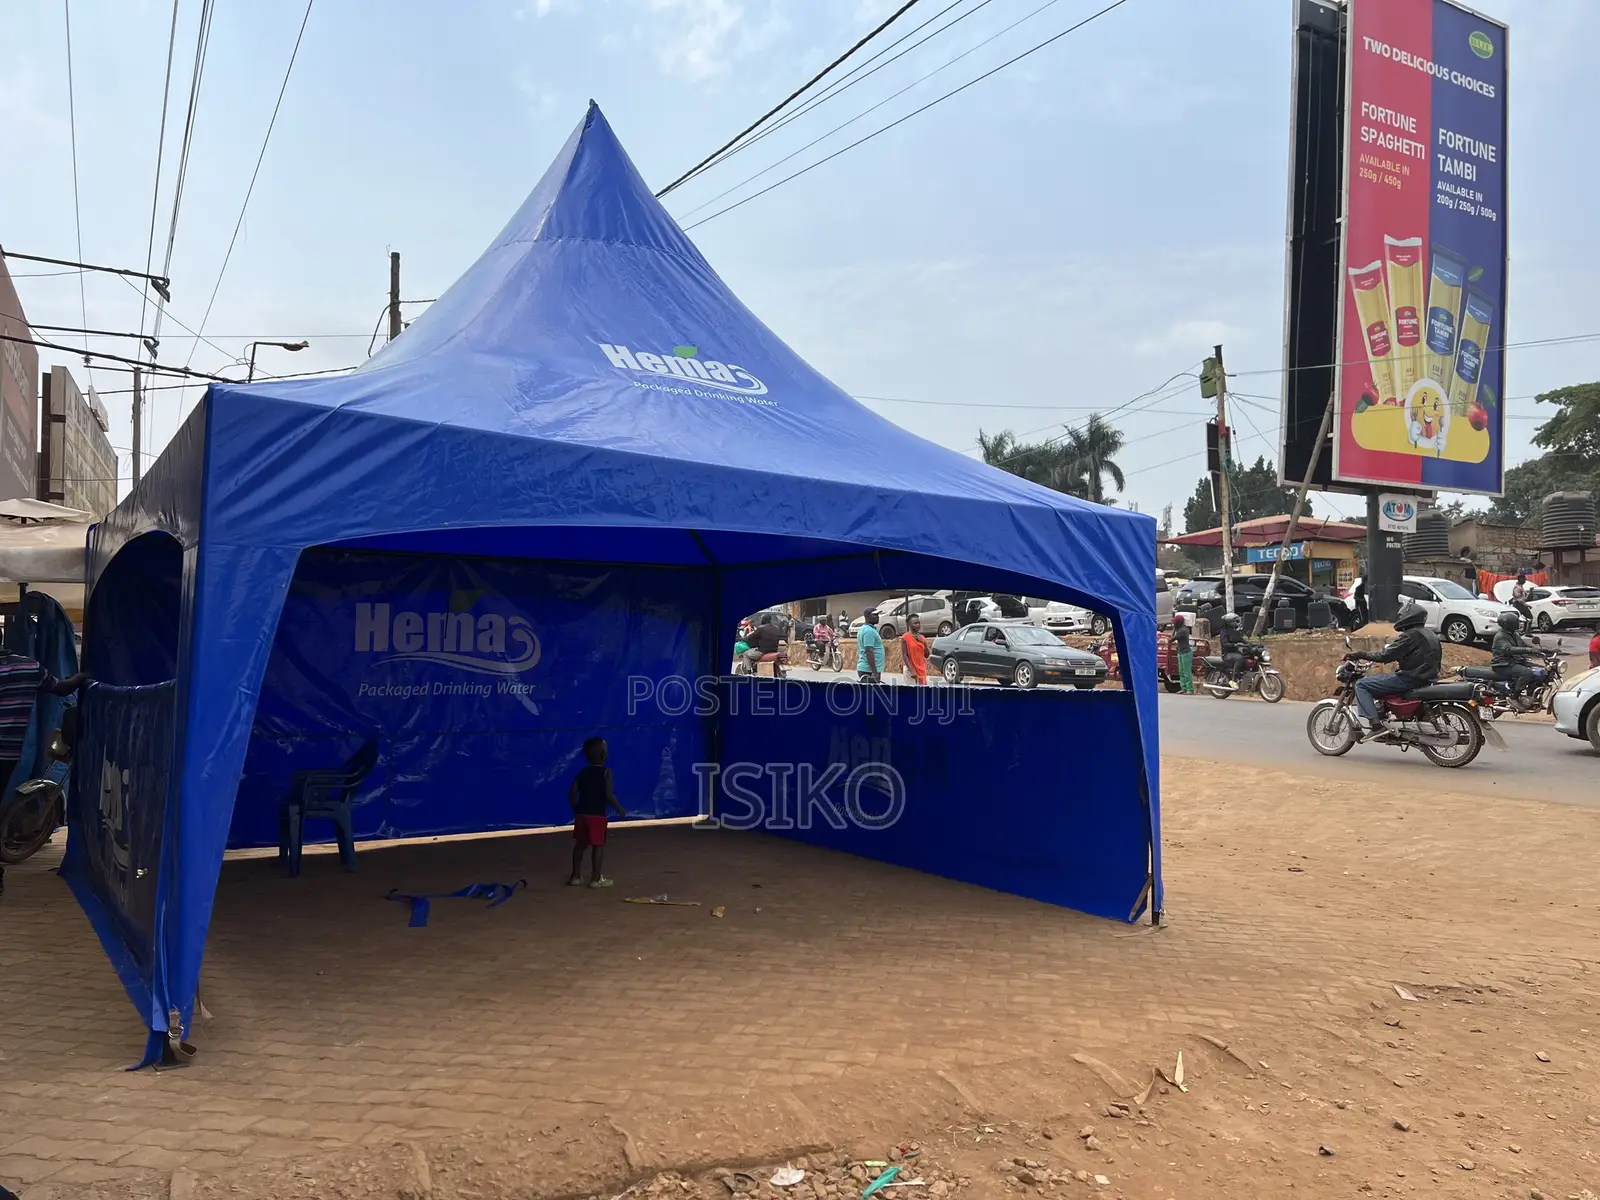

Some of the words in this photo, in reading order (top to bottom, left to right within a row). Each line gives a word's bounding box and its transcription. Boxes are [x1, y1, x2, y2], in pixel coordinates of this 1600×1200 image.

[1363, 36, 1390, 58] TWO
[1392, 48, 1449, 80] DELICIOUS
[1450, 71, 1495, 98] CHOICES
[1361, 101, 1416, 134] FORTUNE
[1360, 126, 1424, 160] SPAGHETTI
[1438, 128, 1496, 162] FORTUNE
[1360, 154, 1400, 174] AVAILABLE
[1402, 166, 1410, 176] IN
[1360, 167, 1378, 183] 250g
[1384, 173, 1402, 190] 450g
[1438, 154, 1476, 182] TAMBI
[1437, 180, 1474, 200] AVAILABLE
[1476, 192, 1483, 202] IN
[1437, 194, 1453, 209] 200g
[1459, 200, 1474, 216] 250g
[1481, 207, 1496, 222] 500g
[1431, 318, 1453, 333] FORTUNE
[599, 343, 738, 384] Hema
[633, 381, 692, 396] Packaged
[695, 390, 744, 404] Drinking
[746, 396, 778, 407] Water
[1386, 502, 1411, 514] ATOM
[1258, 546, 1298, 559] TECO
[354, 602, 506, 653] Hema
[358, 681, 429, 700] Packaged
[433, 681, 492, 698] Drinking
[497, 682, 536, 696] Water
